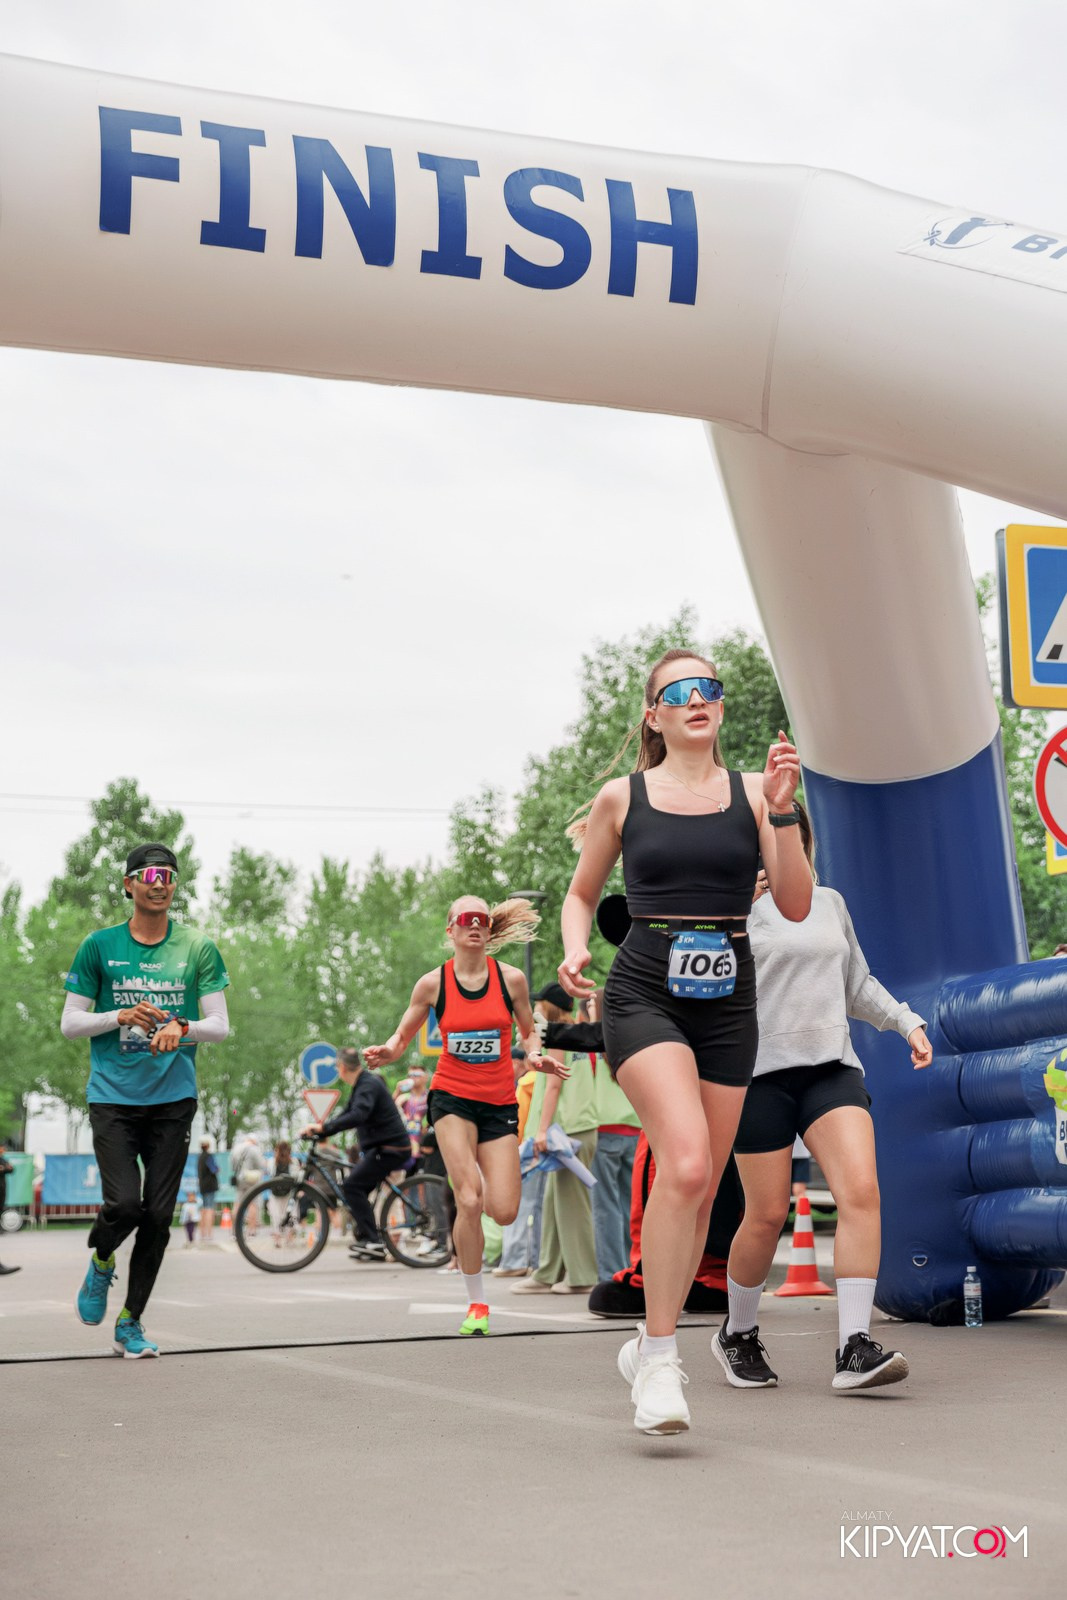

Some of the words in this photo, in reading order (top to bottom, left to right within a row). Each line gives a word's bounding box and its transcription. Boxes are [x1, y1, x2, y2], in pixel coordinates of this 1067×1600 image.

[98, 105, 699, 306] FINISH
[684, 936, 695, 944] KM
[679, 953, 732, 977] 1065
[455, 1041, 494, 1054] 1325
